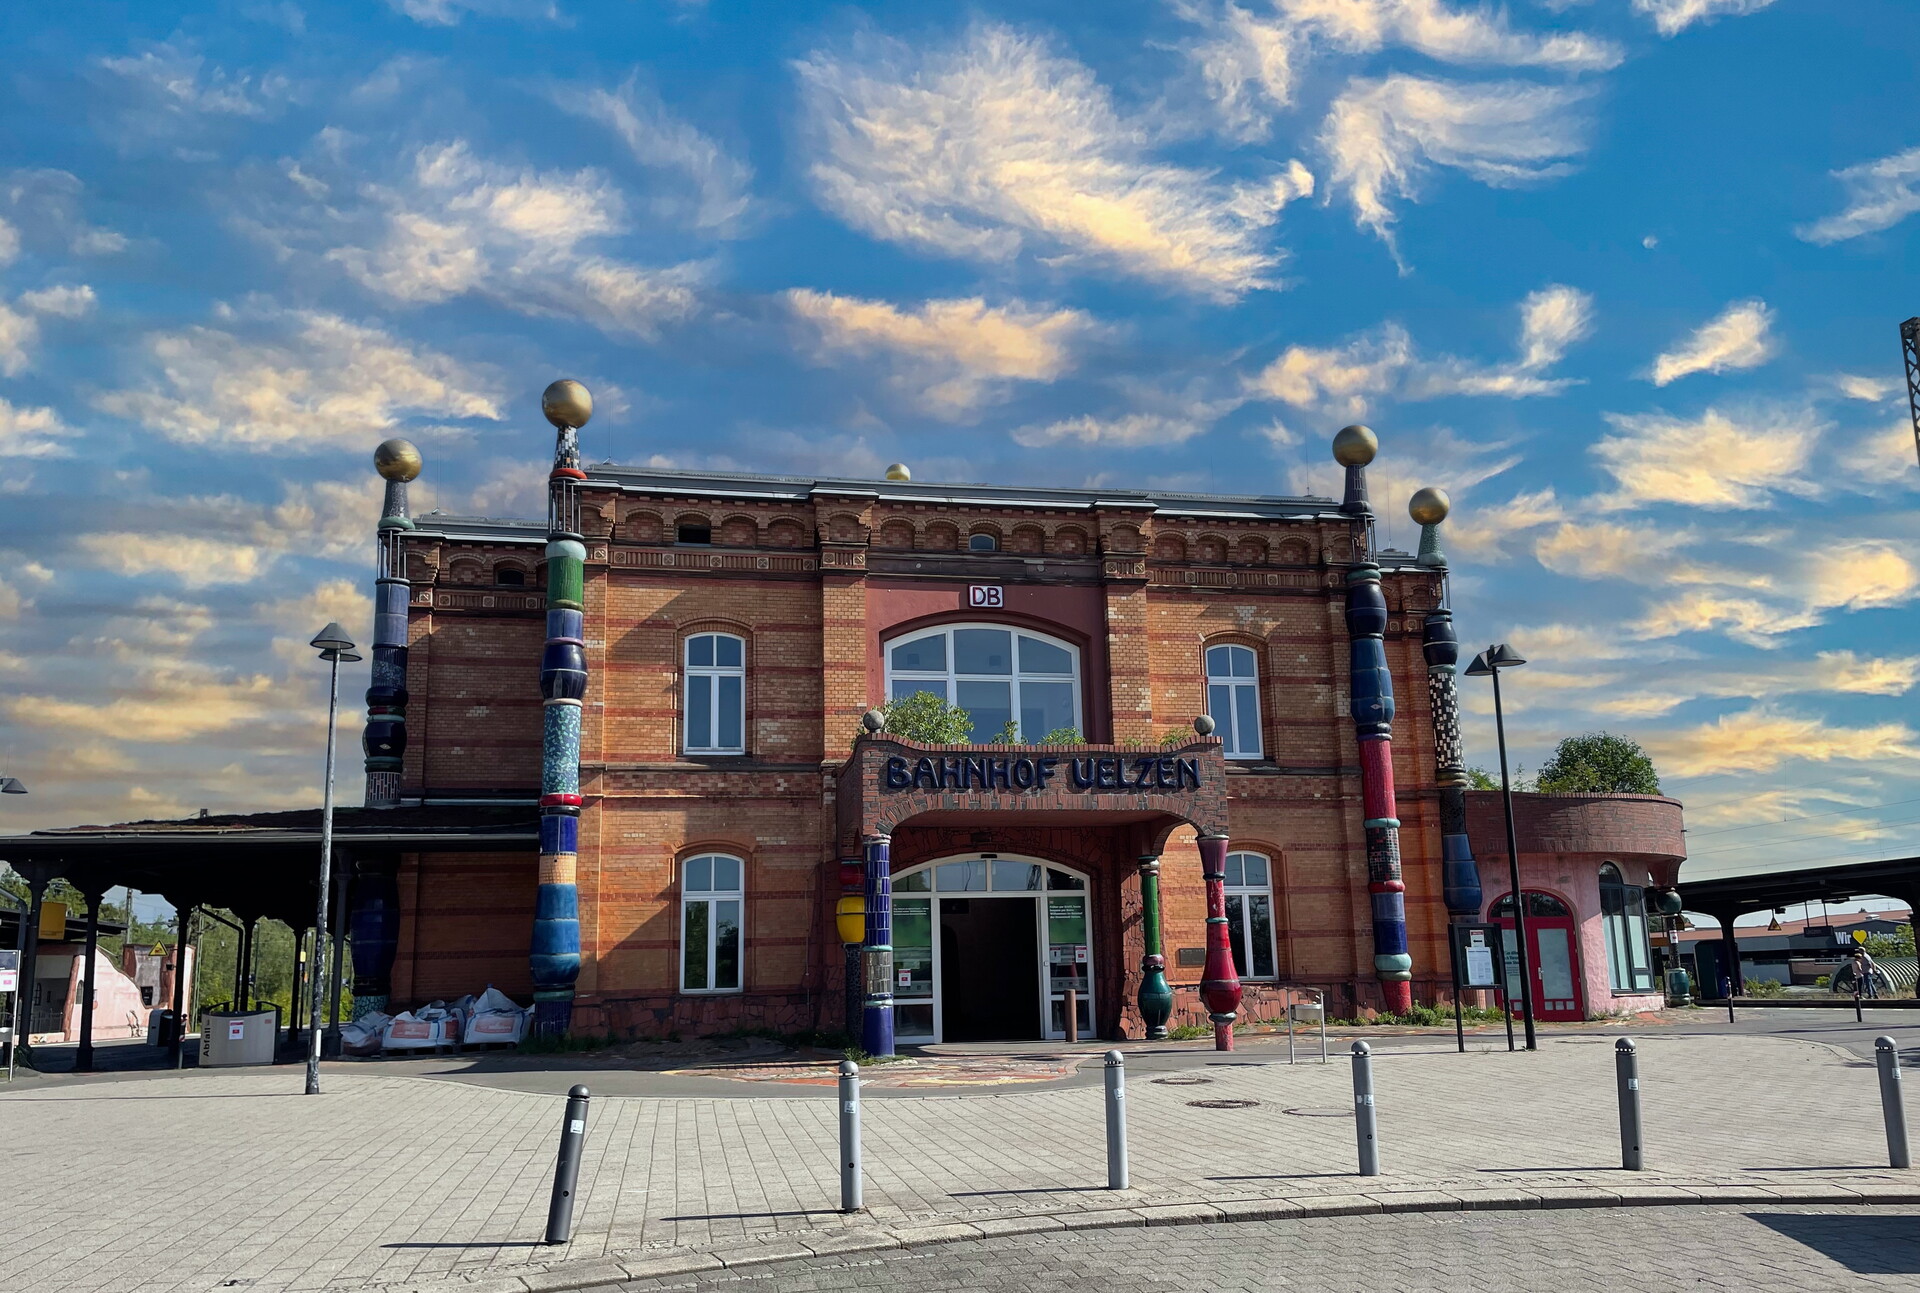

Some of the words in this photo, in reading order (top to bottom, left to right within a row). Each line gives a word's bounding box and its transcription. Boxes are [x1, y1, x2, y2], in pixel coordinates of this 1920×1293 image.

[972, 586, 1001, 606] DB
[886, 756, 1059, 790] BAHNHOF
[1072, 757, 1200, 790] UELZEN
[1836, 931, 1851, 944] Wir
[203, 1027, 211, 1057] Abfall
